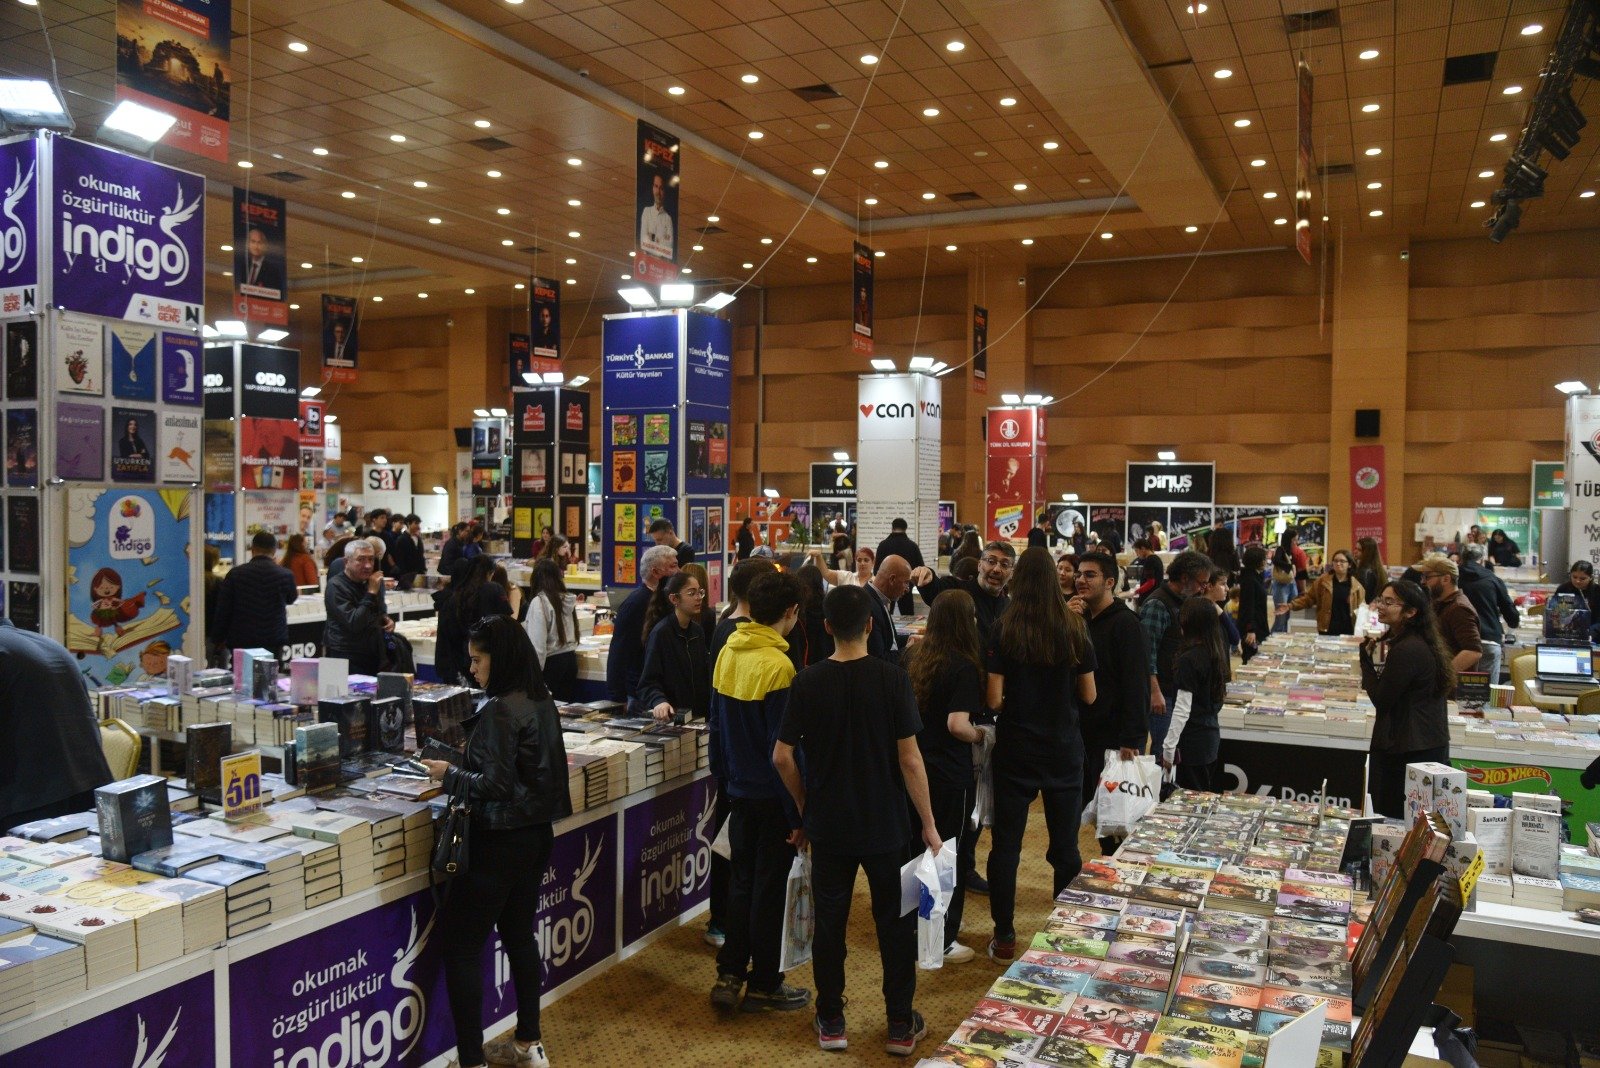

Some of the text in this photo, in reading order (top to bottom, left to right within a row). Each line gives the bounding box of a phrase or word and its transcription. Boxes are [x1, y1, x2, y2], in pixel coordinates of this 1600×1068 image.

[79, 174, 141, 201] okumak
[62, 190, 155, 226] özgürlüktür
[63, 212, 185, 281] indigo
[606, 352, 674, 362] TÜRKİYE BANKASI
[616, 371, 662, 380] Kültür Yayınları
[876, 403, 914, 418] can
[926, 402, 941, 419] can
[242, 455, 267, 465] Nazım
[269, 456, 298, 466] Hikmet
[1144, 475, 1193, 493] pinus
[730, 497, 791, 521] PEZ
[1004, 523, 1016, 533] 15
[225, 773, 260, 808] 50
[1118, 780, 1154, 799] can
[650, 809, 685, 837] okumak
[641, 827, 693, 862] özgürlüktür
[641, 846, 709, 908] indigo
[292, 948, 368, 997] okumak
[1052, 968, 1081, 979] SATRANÇ
[1129, 988, 1161, 998] SATRANÇ
[272, 972, 385, 1039] özgürlüktür
[1210, 1026, 1236, 1037] DAVA
